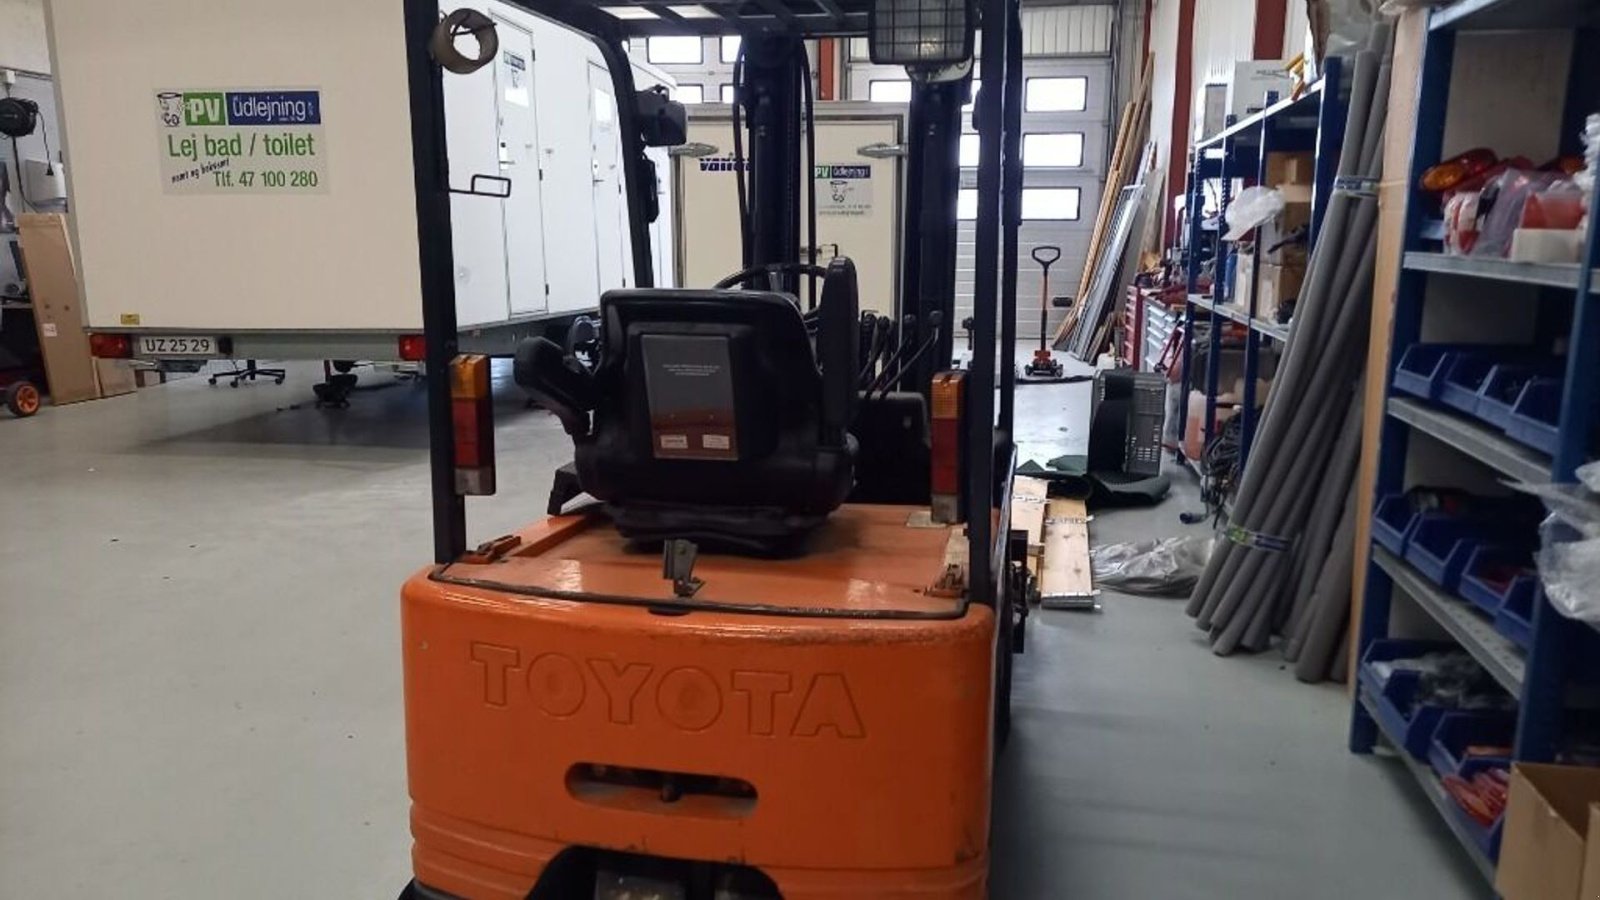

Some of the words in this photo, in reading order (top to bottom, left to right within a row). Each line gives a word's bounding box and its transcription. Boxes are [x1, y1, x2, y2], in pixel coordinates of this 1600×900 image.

[190, 98, 220, 123] PV
[168, 133, 198, 162] Lej
[204, 132, 242, 156] bad
[248, 132, 257, 157] /
[263, 132, 315, 156] toilet
[213, 170, 235, 187] Tlf.
[239, 171, 255, 187] 47
[261, 170, 286, 187] 100
[290, 170, 319, 187] 280
[815, 167, 829, 178] PV
[145, 339, 166, 352] UZ
[170, 339, 187, 352] 25
[190, 339, 210, 352] 29
[470, 641, 867, 739] TOYOTA
